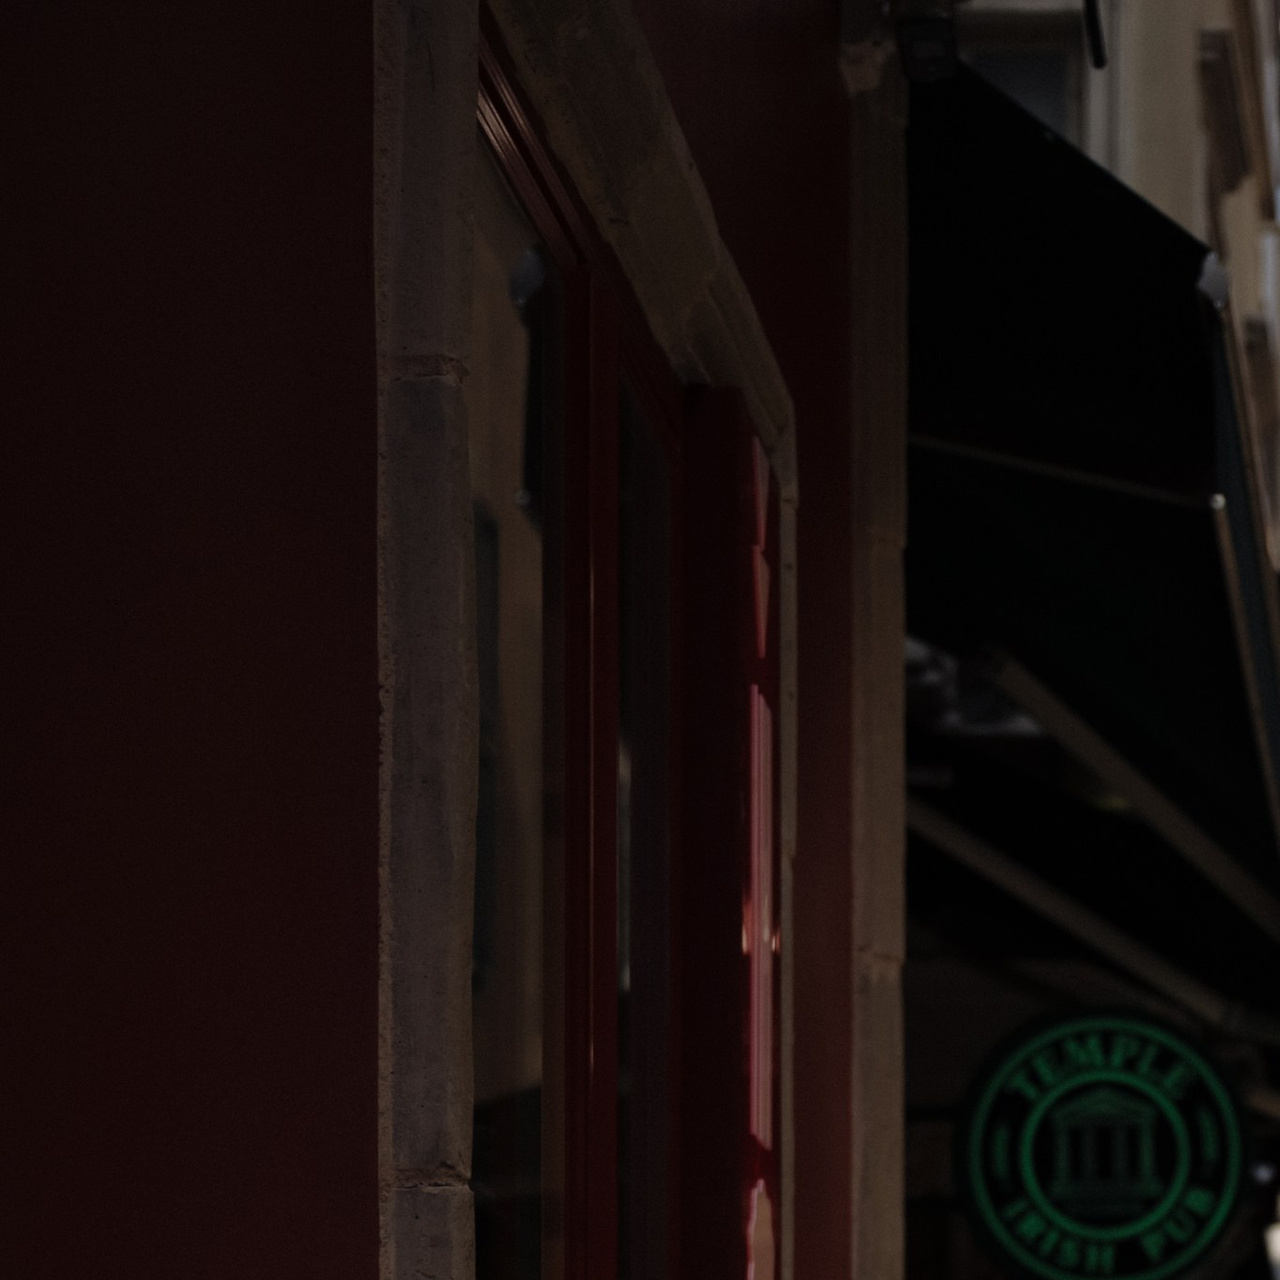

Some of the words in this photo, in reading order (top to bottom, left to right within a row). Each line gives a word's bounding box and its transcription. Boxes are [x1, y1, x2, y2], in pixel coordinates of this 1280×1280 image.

[1002, 1035, 1195, 1100] TEMPLE
[1001, 1196, 1117, 1273] IRISH
[1138, 1186, 1216, 1262] PUB
